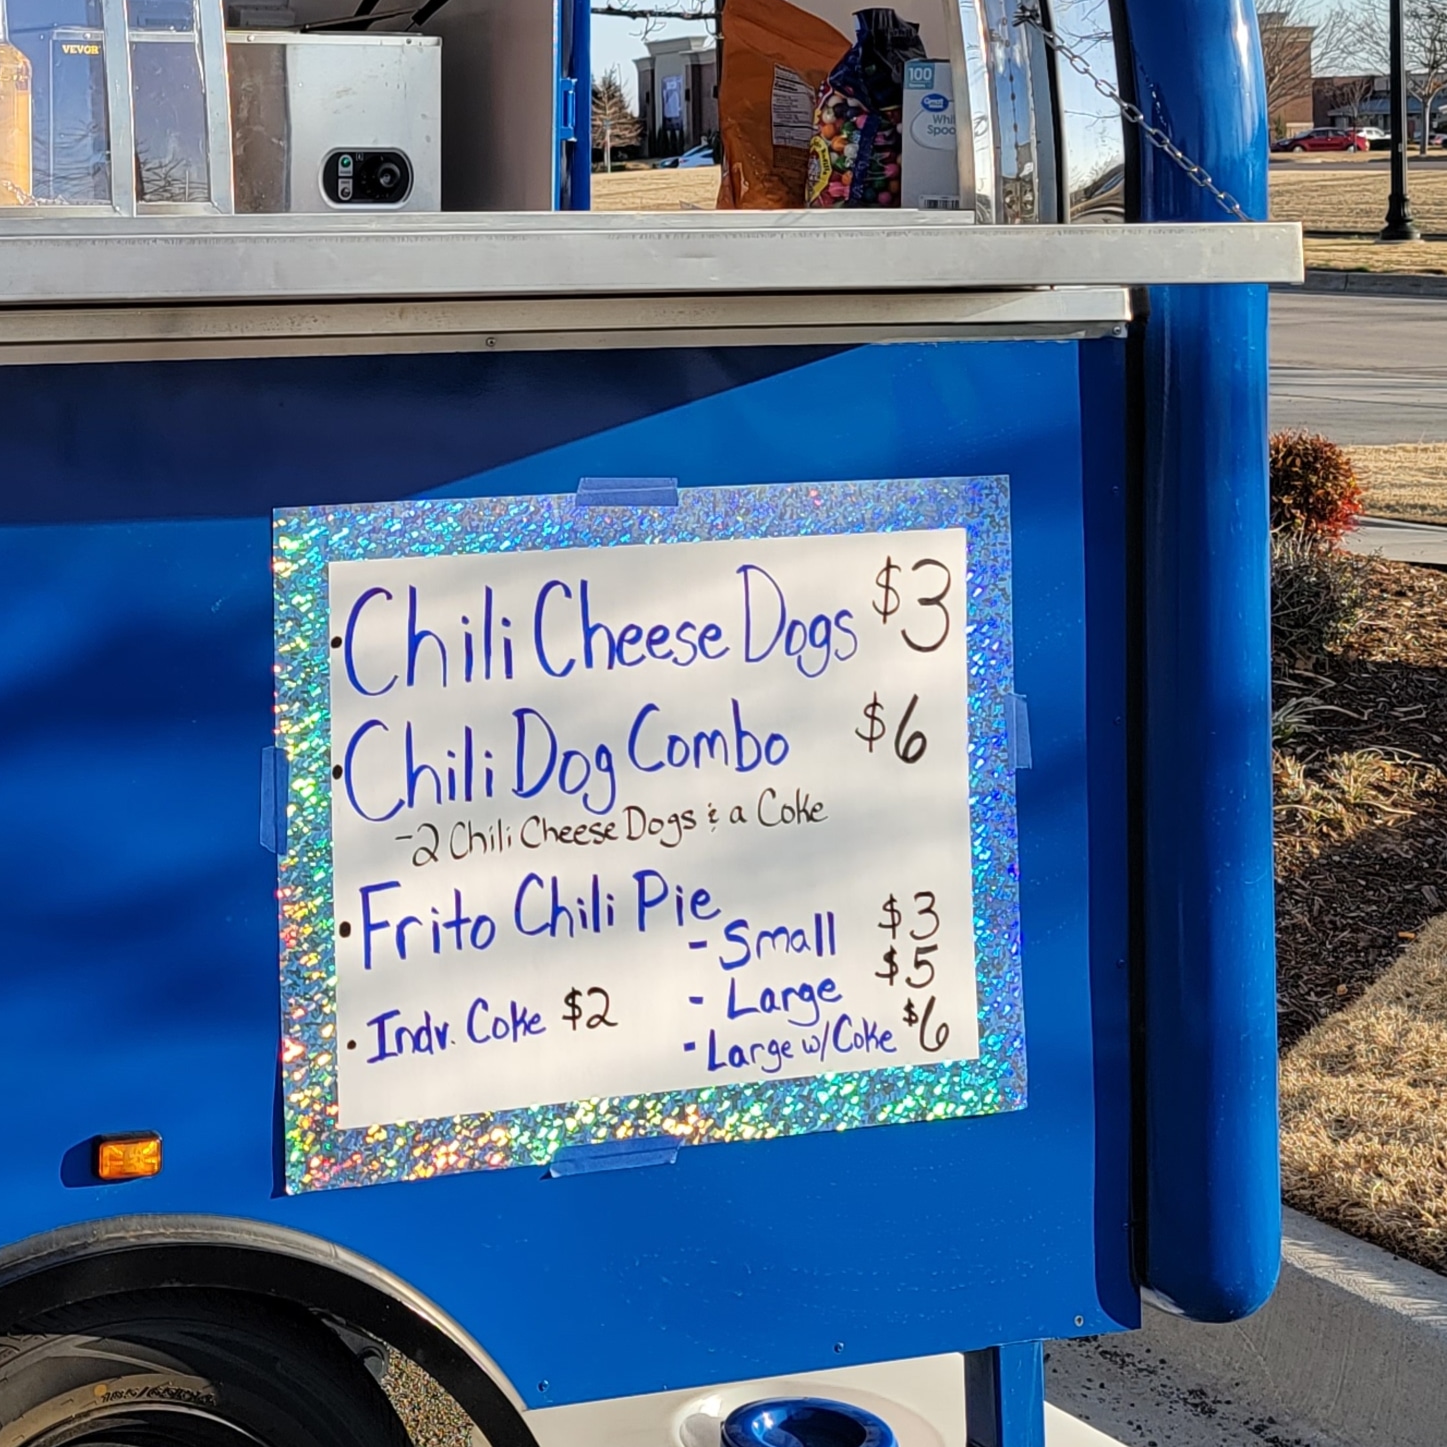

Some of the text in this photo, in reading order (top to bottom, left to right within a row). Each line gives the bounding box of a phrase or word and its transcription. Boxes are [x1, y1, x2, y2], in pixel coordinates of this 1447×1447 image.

[62, 44, 99, 54] VEVOR
[909, 68, 932, 81] 100
[346, 556, 951, 696] Chili Cheese Dogs $3
[346, 693, 927, 822] Chili Dog Combo $6
[450, 818, 512, 859] Chili
[520, 815, 618, 848] Cheese
[623, 805, 697, 848] Dogs
[729, 807, 747, 823] a
[757, 787, 828, 826] Coke
[360, 870, 721, 970] Frito Chili Pie
[719, 891, 939, 971] Small $3
[727, 944, 938, 1026] Large $5
[367, 987, 617, 1063] Indv. Coke $2
[708, 995, 949, 1073] Large w/Coke $6
